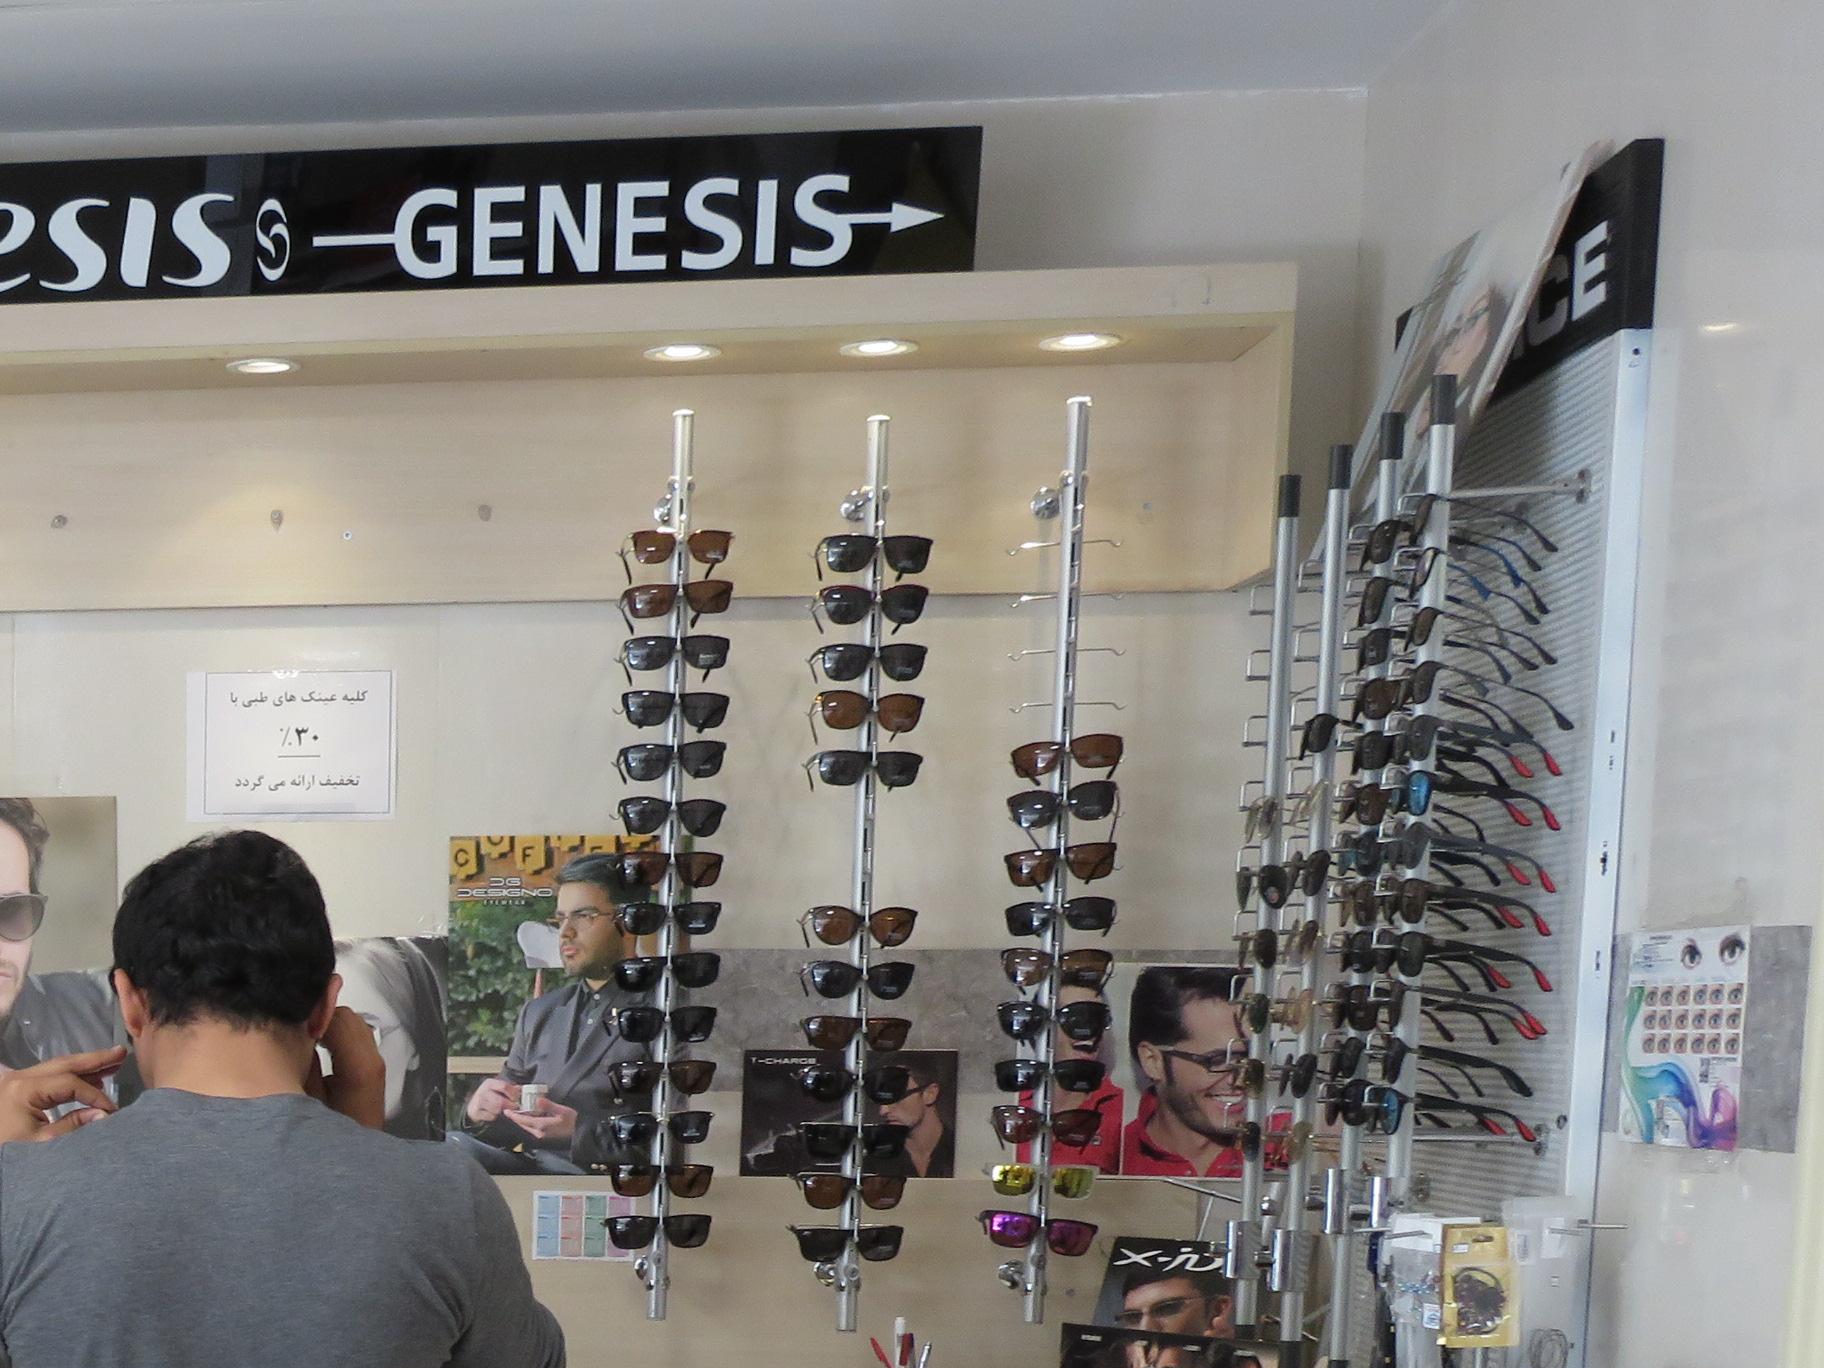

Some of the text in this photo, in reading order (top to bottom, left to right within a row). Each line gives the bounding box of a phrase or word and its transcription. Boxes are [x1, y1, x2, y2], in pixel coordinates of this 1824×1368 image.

[394, 174, 853, 280] GENESIS
[230, 690, 368, 707] کلیه عینک های طبی با
[235, 775, 360, 791] تخفیف ارائه می گردد
[457, 888, 553, 897] DESIGNO
